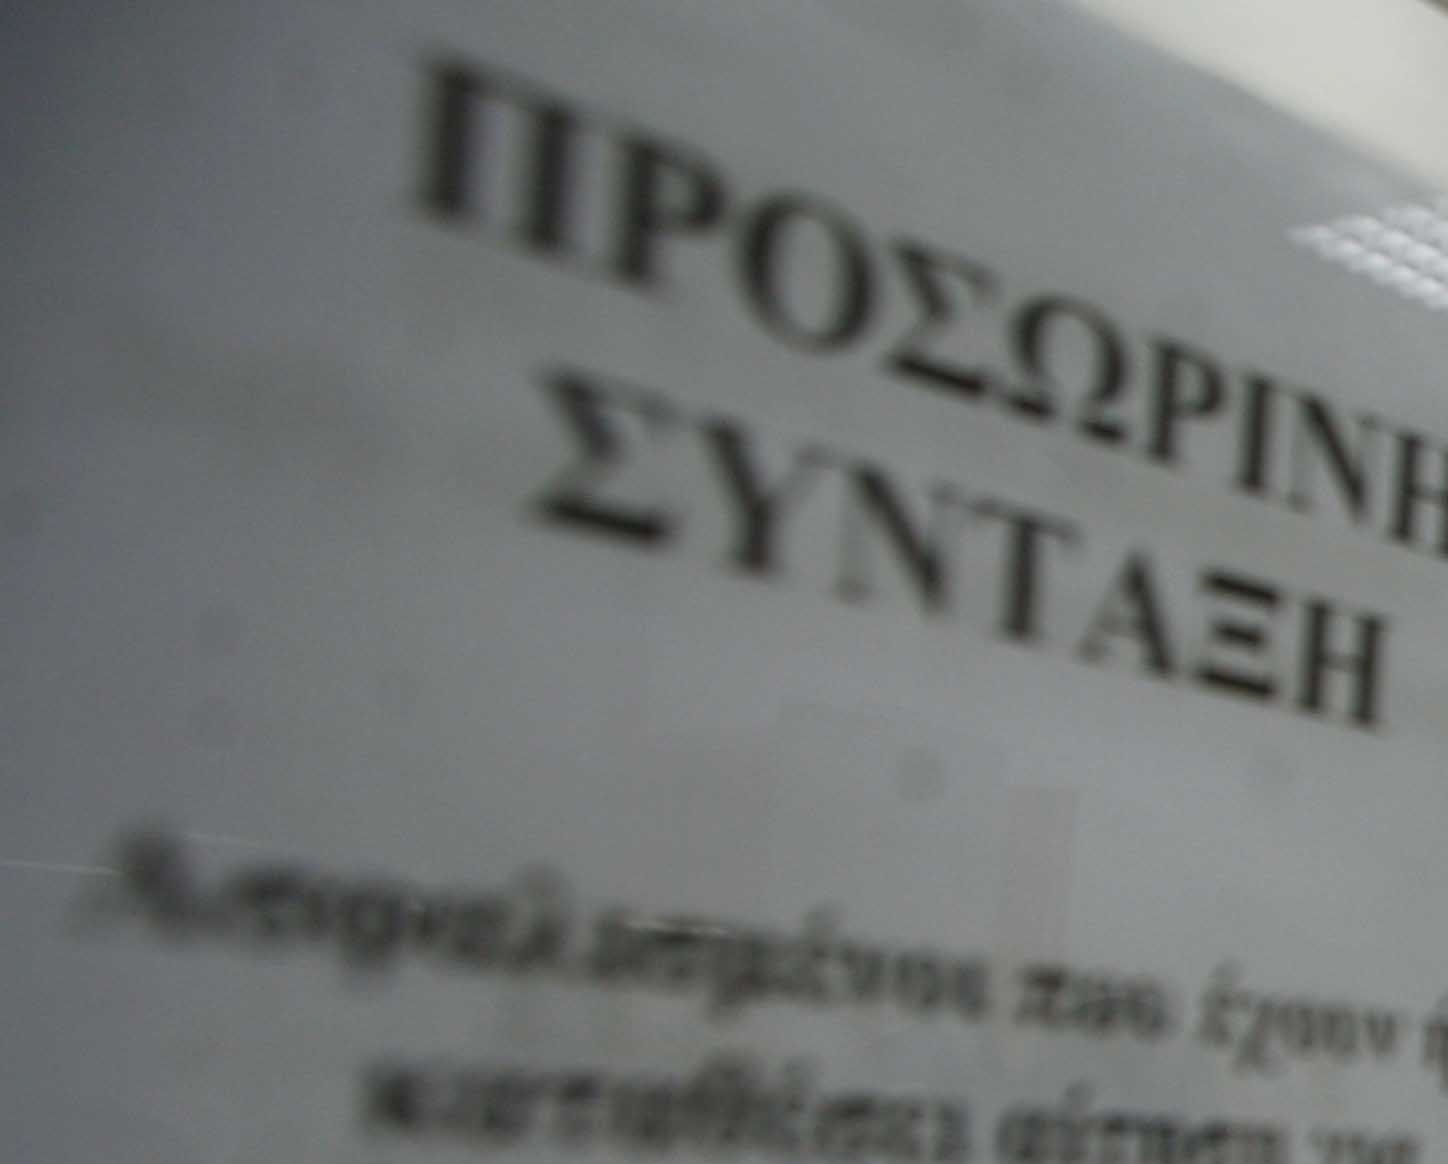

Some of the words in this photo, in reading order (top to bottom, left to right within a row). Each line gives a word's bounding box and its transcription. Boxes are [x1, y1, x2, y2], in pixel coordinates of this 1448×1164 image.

[530, 360, 1392, 732] ΣΥΝΤΑΞΗ
[1012, 960, 1176, 1044] που
[1196, 956, 1404, 1077] έχουν
